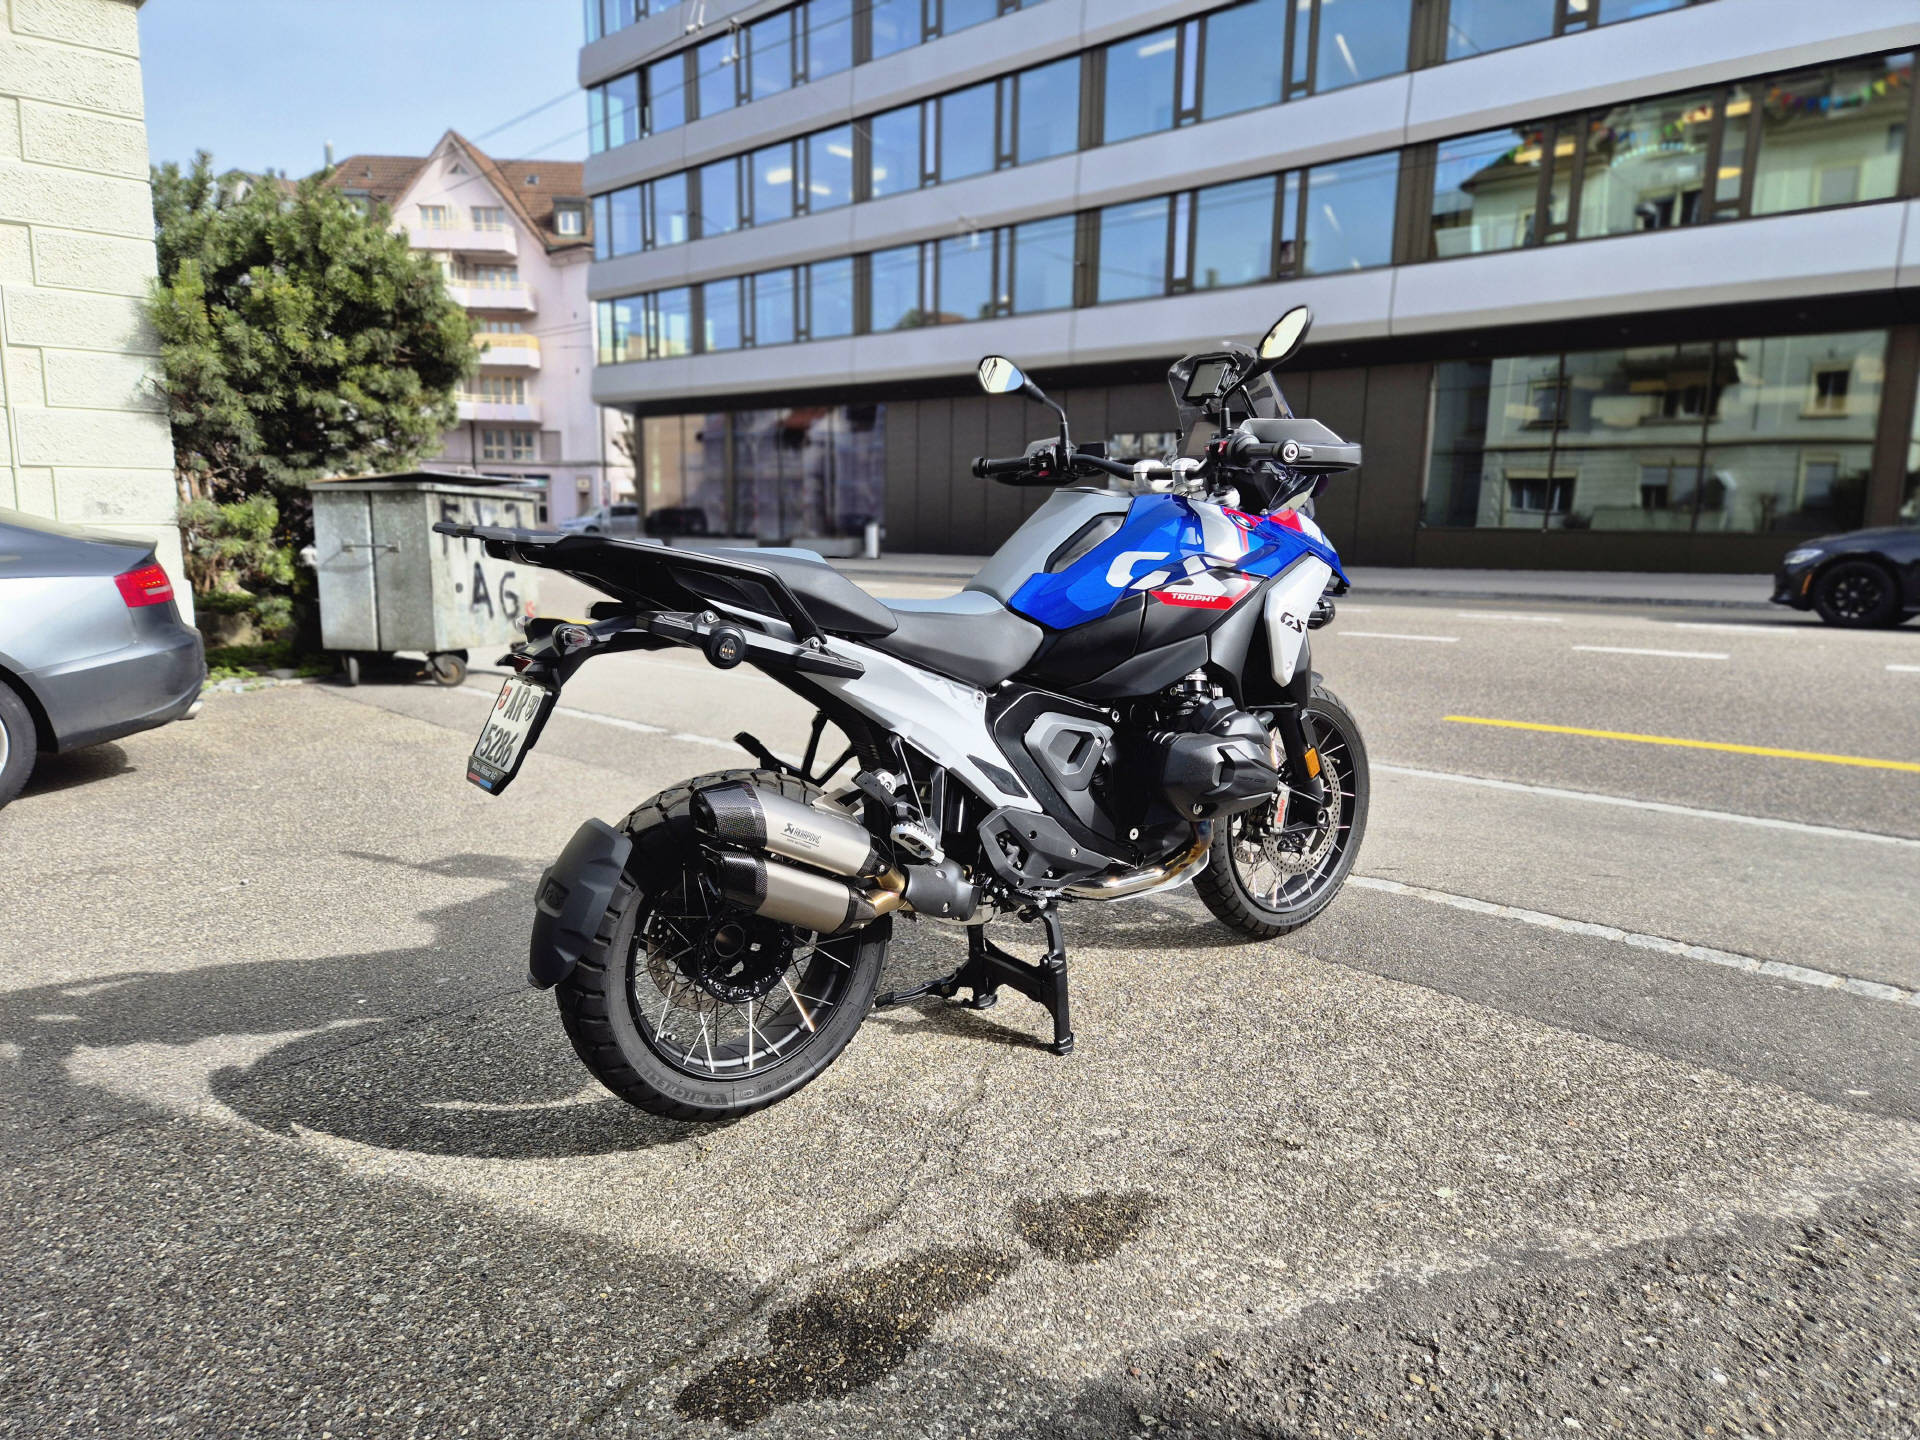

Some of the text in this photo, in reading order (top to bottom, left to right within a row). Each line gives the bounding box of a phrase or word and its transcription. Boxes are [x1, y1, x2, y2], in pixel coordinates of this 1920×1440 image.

[1105, 551, 1236, 596] GS
[1171, 592, 1218, 603] TROPHY
[1280, 612, 1306, 633] GS
[503, 685, 531, 722] AR
[480, 723, 519, 768] 5286
